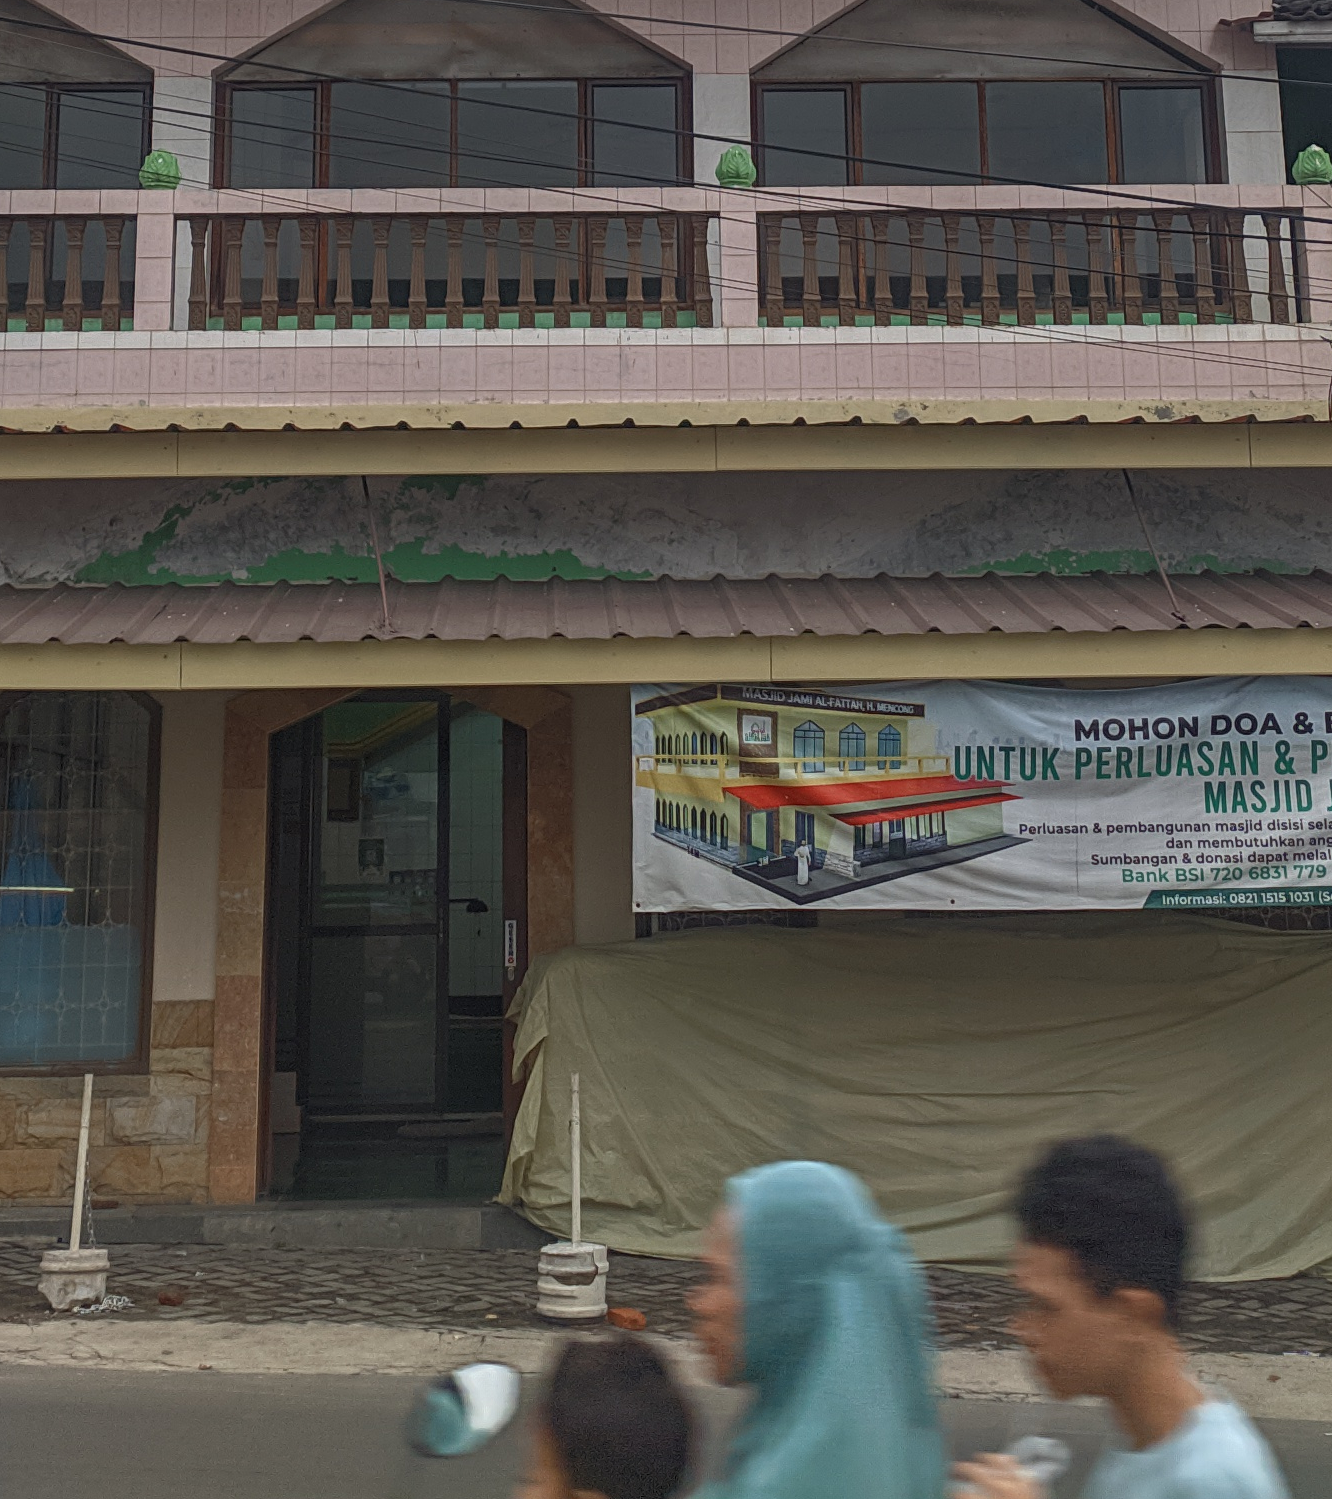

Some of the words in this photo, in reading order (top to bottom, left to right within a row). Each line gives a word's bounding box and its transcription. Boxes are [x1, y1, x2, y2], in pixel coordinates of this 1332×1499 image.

[742, 687, 786, 702] MASJID
[787, 693, 813, 705] JAMI
[1074, 715, 1199, 742] MOHON
[1210, 713, 1282, 737] DOA
[1293, 712, 1314, 735] &
[954, 745, 1061, 781] UNTUK
[1074, 740, 1260, 781] PERLUASAN
[1274, 740, 1296, 775] &
[1204, 779, 1313, 814] MASJID
[1019, 823, 1088, 835] Perluasan
[1092, 823, 1102, 833] &
[1106, 820, 1211, 836] pembangunan
[1216, 820, 1263, 834] masjid
[1267, 818, 1304, 831] disisi
[1166, 836, 1193, 849] dan
[1197, 835, 1305, 849] membutuhkan
[1091, 853, 1178, 867] Sumbangan
[1182, 853, 1192, 864] &
[1195, 851, 1243, 864] donasi
[1247, 851, 1289, 865] dapat
[1122, 868, 1170, 883] Bank
[1175, 867, 1205, 882] BSI
[1212, 866, 1243, 881] 720
[1249, 865, 1288, 880] 6831
[1293, 864, 1327, 879] 779
[1162, 893, 1227, 906] Informasi:
[1229, 893, 1258, 905] 0821
[1262, 892, 1286, 904] 1515
[1289, 891, 1315, 903] 1031
